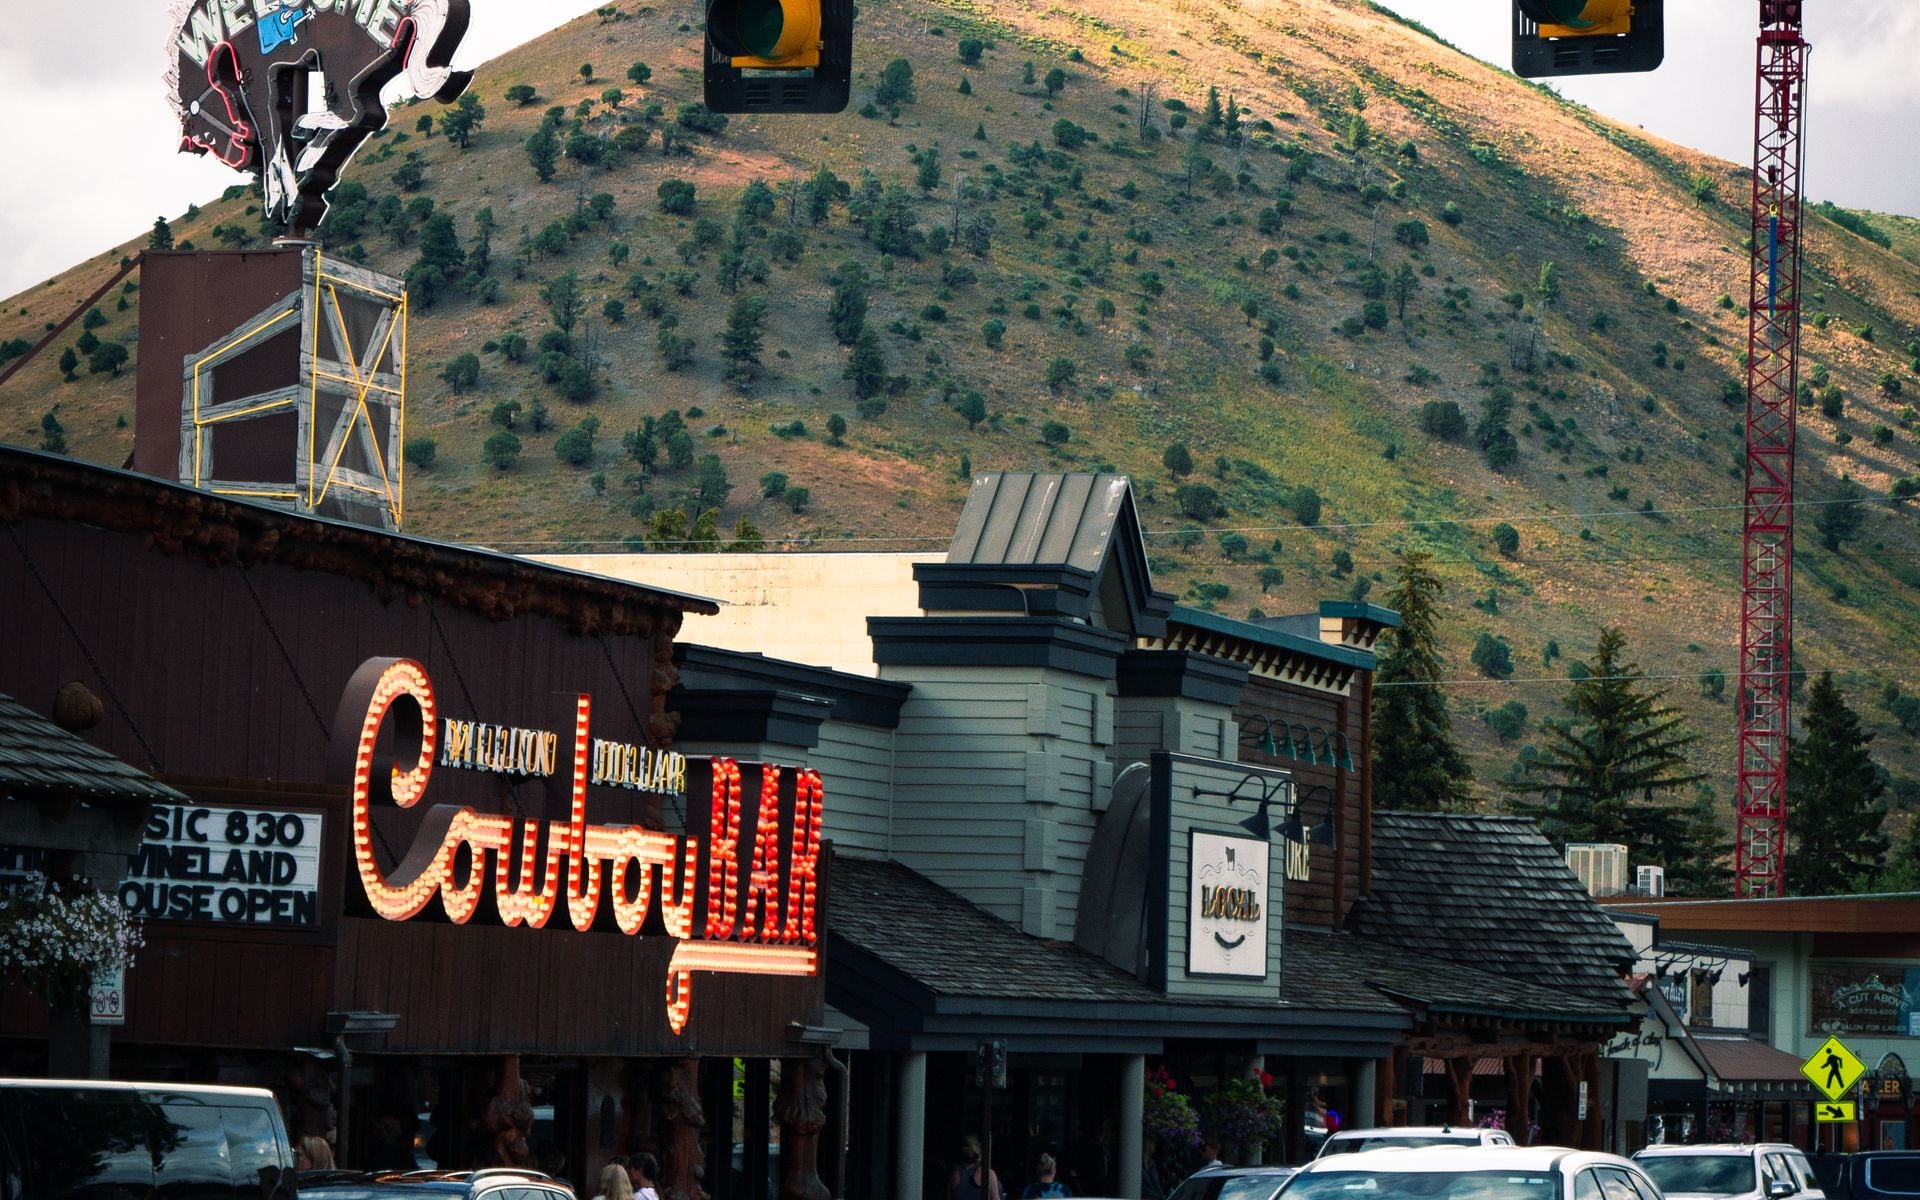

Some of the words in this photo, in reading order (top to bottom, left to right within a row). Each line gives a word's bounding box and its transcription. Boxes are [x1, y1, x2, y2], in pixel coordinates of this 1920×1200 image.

[176, 0, 408, 70] WEME
[592, 738, 686, 796] DOLLAR
[352, 656, 699, 1035] Cowboy
[705, 756, 823, 946] BAR
[219, 887, 317, 925] OPEN
[1201, 885, 1261, 923] LOCAL
[1848, 992, 1870, 1004] CUT
[1874, 992, 1910, 1013] ABOVE
